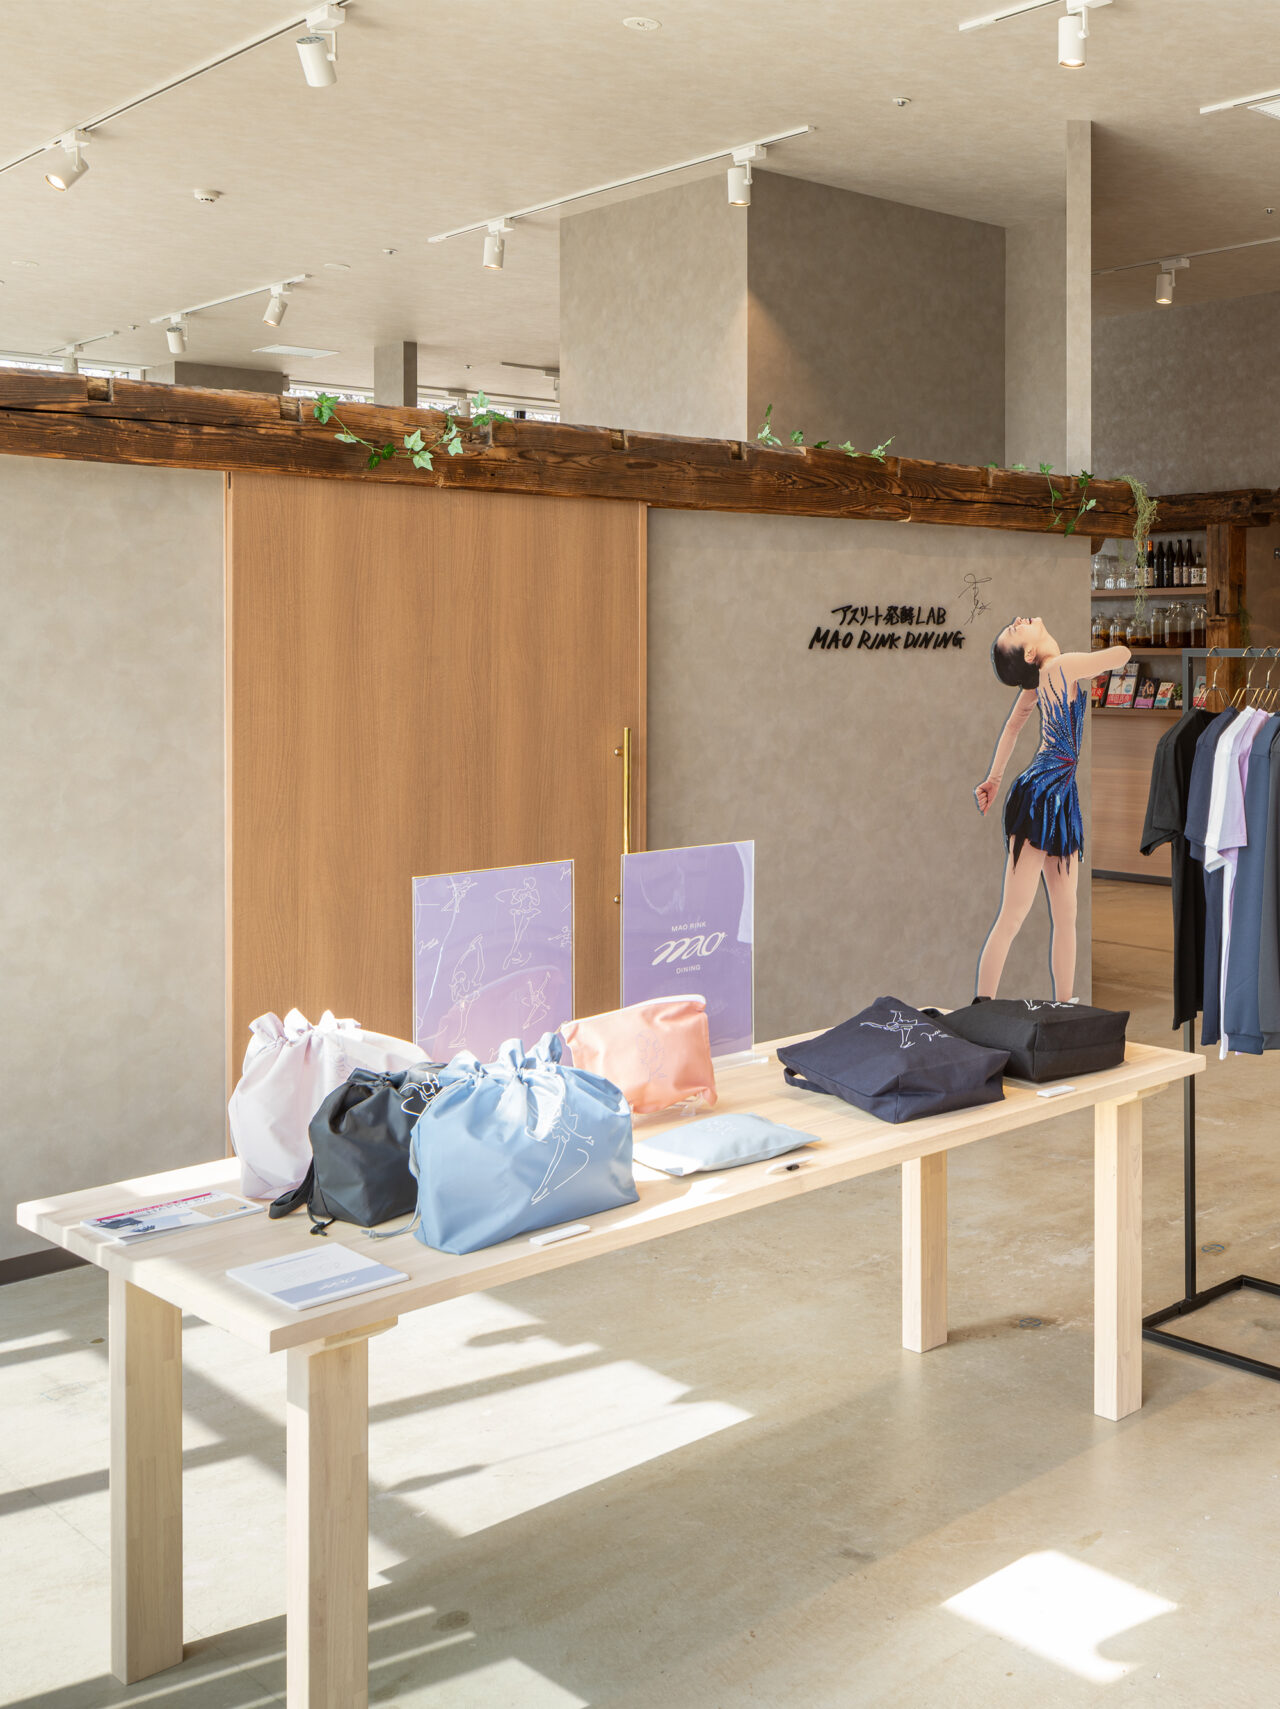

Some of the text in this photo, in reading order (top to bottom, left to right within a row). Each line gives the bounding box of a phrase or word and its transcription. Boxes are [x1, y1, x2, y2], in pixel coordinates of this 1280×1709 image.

[808, 626, 966, 650] MAO RINK DINING
[671, 923, 689, 932] MAO
[675, 964, 701, 975] DINING
